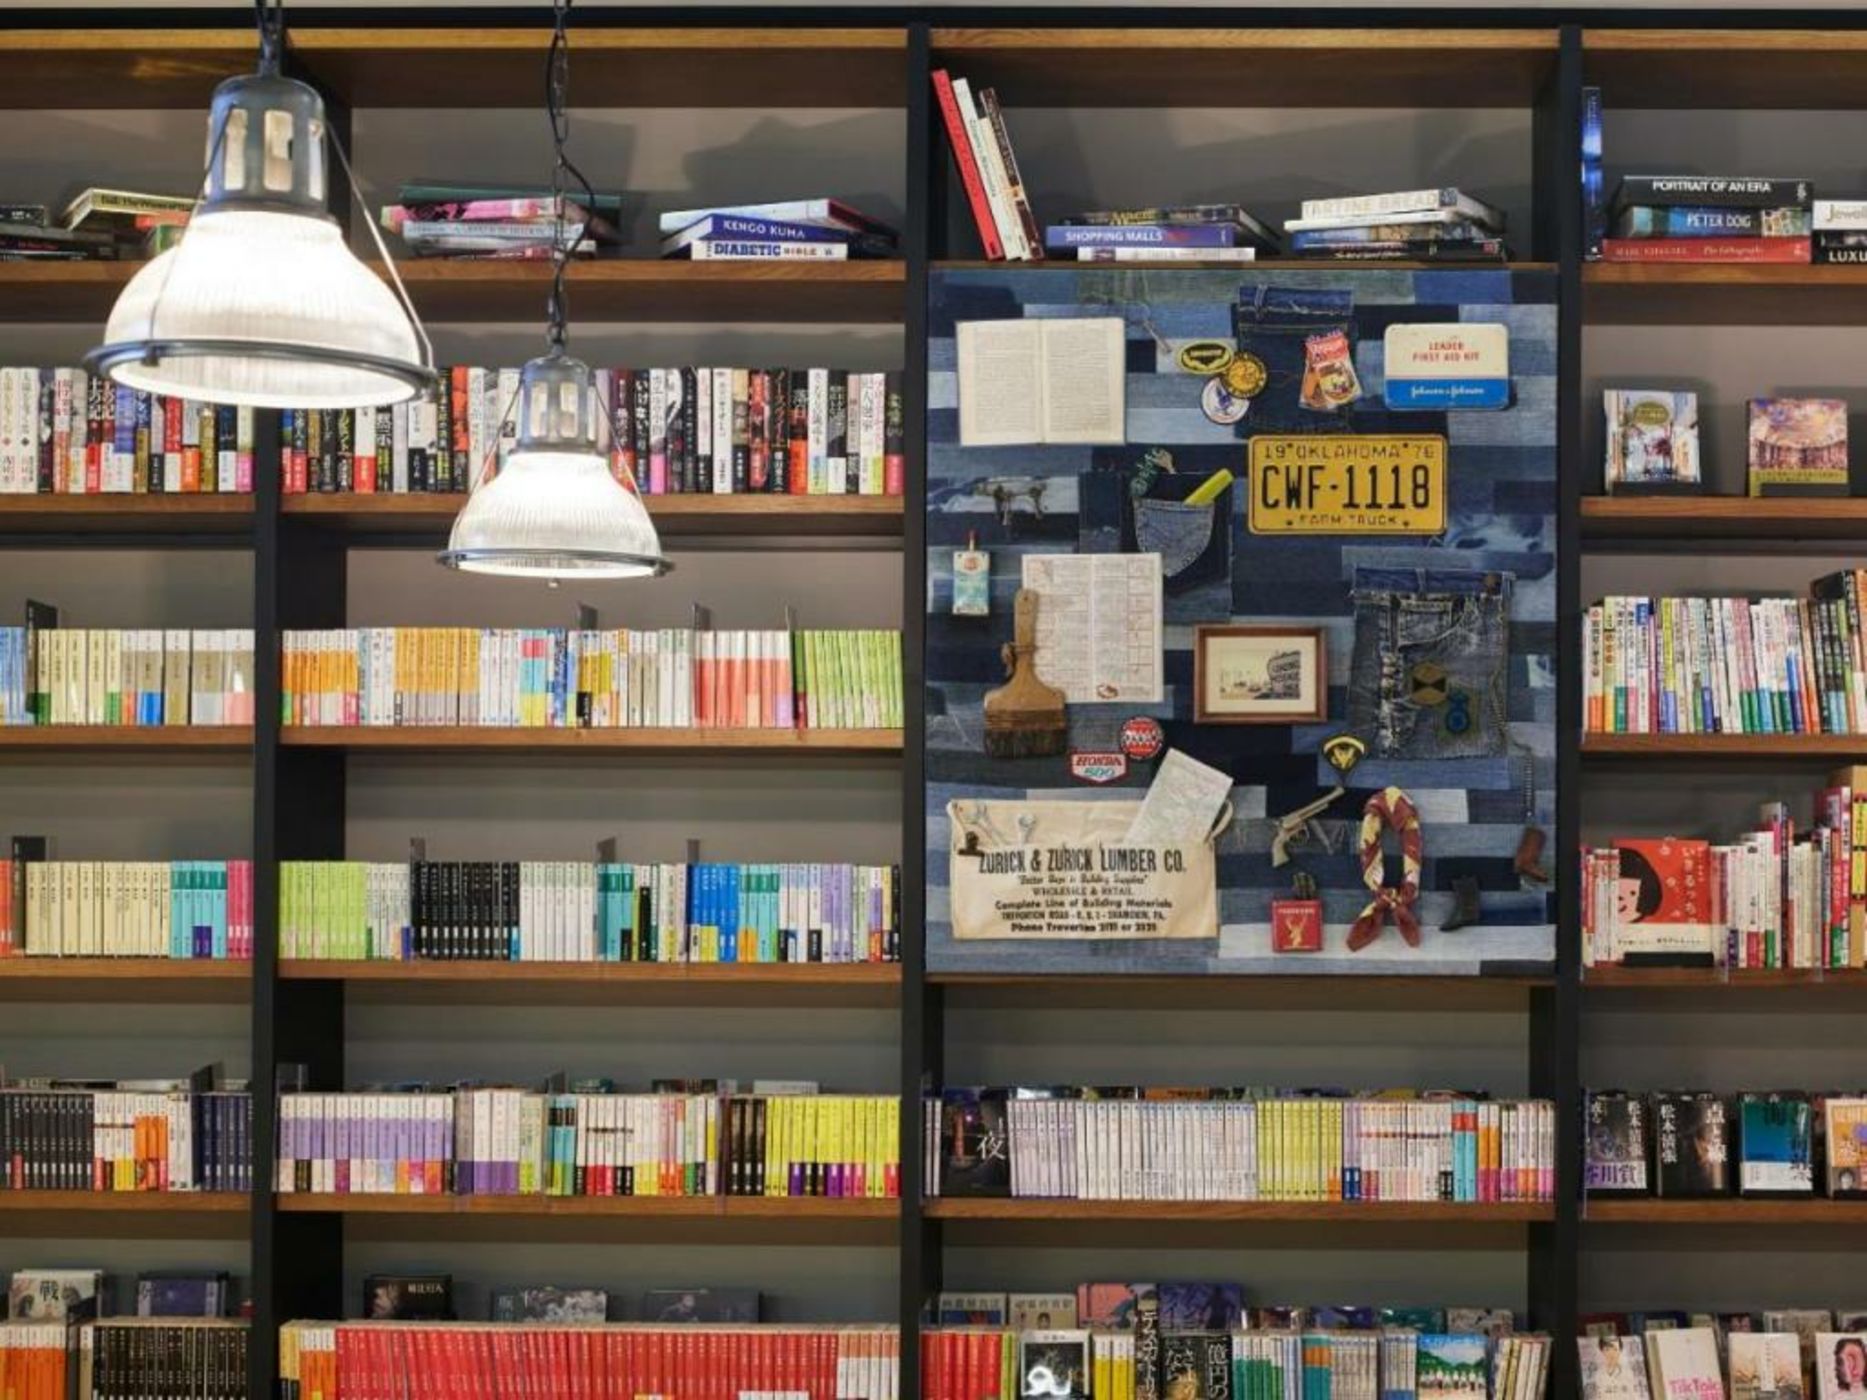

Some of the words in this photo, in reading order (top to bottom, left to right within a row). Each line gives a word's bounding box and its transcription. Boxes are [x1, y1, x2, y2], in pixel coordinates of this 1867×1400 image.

[1652, 181, 1708, 192] PORTRAIT
[1711, 181, 1726, 192] OF
[1728, 181, 1745, 192] AN
[1747, 181, 1771, 193] ERA
[1686, 212, 1723, 227] PETER
[723, 220, 766, 234] KENGO
[769, 224, 805, 239] KUMA
[1065, 230, 1123, 242] SHOPPING
[1125, 231, 1164, 242] MALLS
[714, 243, 781, 256] DIABETIC
[1429, 341, 1464, 351] LEADER
[1412, 352, 1440, 362] FIRST
[1444, 352, 1460, 361] AID
[1463, 352, 1480, 361] KIT
[1264, 446, 1286, 459] 19
[1296, 445, 1401, 459] OKLAHOMA
[1414, 445, 1435, 459] 76
[1261, 465, 1430, 510] CWF-1118
[1299, 514, 1341, 525] FARM
[1349, 514, 1398, 525] TRUCK
[1075, 756, 1122, 766] HONDA
[978, 850, 1026, 874] ZURICK
[1031, 848, 1042, 872] &
[1047, 848, 1093, 872] ZURICK
[1100, 848, 1157, 873] LUMBER
[1164, 849, 1187, 873] CO.
[1101, 887, 1132, 896] RETAIL
[995, 900, 1041, 910] Complete
[1045, 900, 1065, 908] Line
[1069, 899, 1078, 908] of
[1083, 899, 1121, 909] Building
[1126, 899, 1173, 909] Materials
[1011, 922, 1043, 932] Phone
[1121, 924, 1132, 932] or
[1660, 1104, 1678, 1164] 松本清張
[977, 1131, 1006, 1161] 夜
